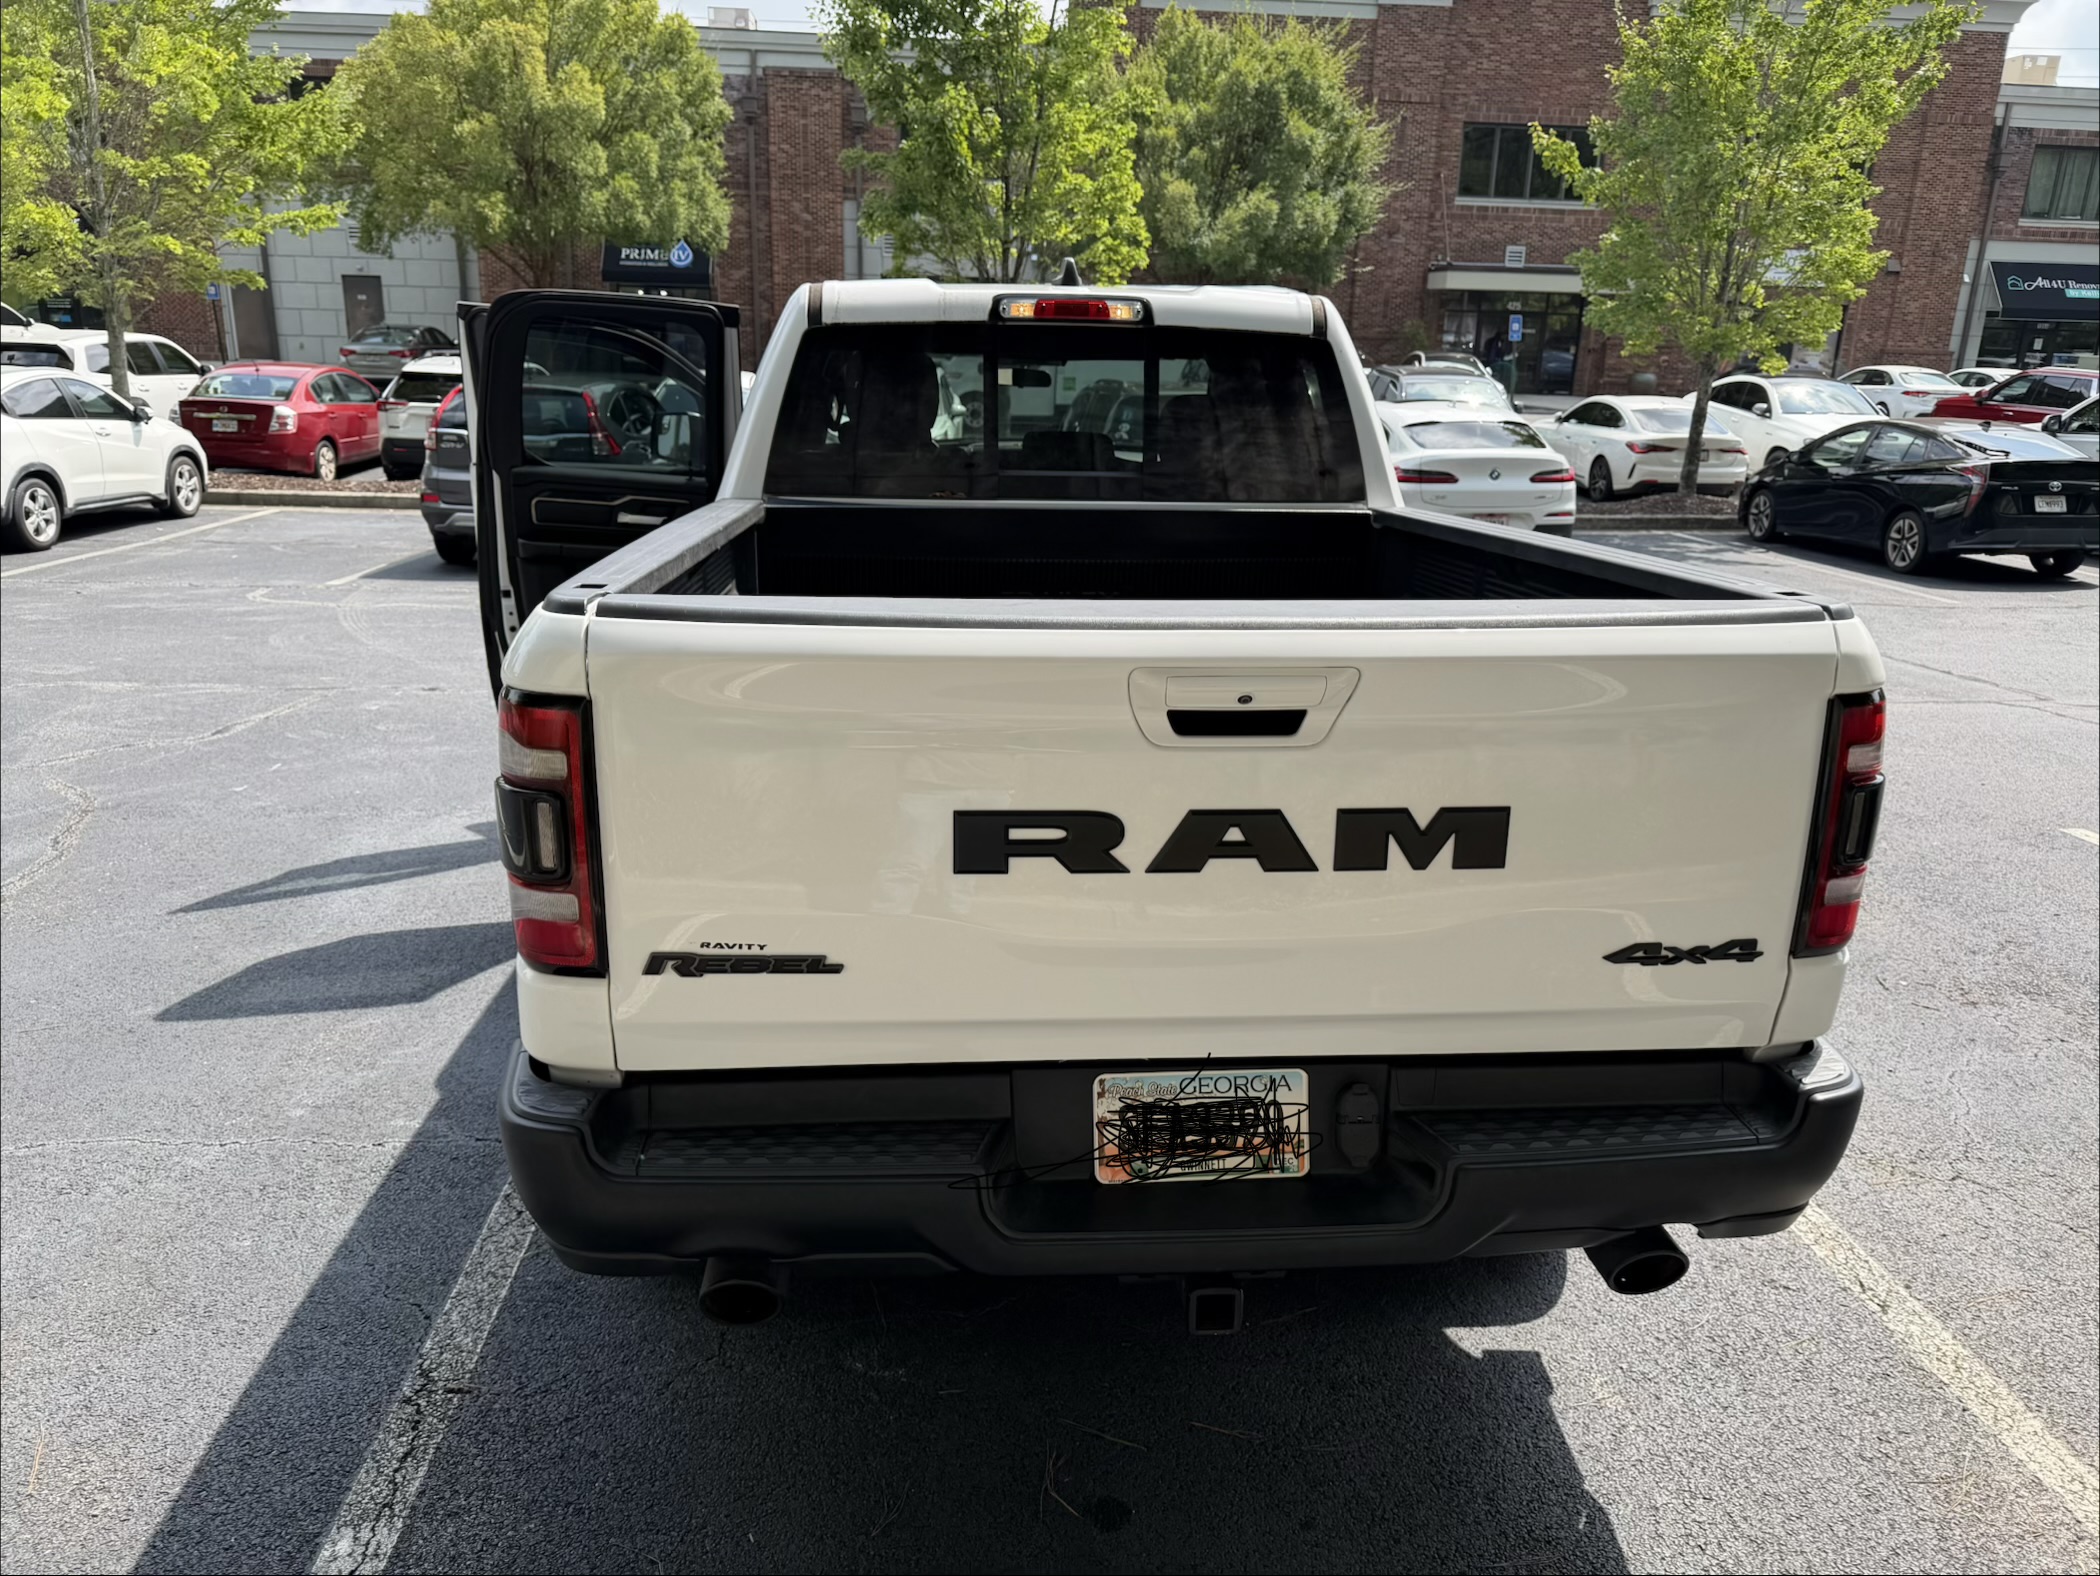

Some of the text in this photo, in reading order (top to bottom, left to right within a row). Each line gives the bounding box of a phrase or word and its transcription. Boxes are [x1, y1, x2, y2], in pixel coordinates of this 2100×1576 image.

[674, 250, 689, 261] IV
[2024, 275, 2067, 291] All4U
[953, 805, 1512, 875] RAM
[699, 941, 768, 951] RAVITY
[1602, 938, 1764, 966] 4x4
[641, 951, 845, 978] REBEL
[1106, 1073, 1293, 1098] Peach State GEORGIA
